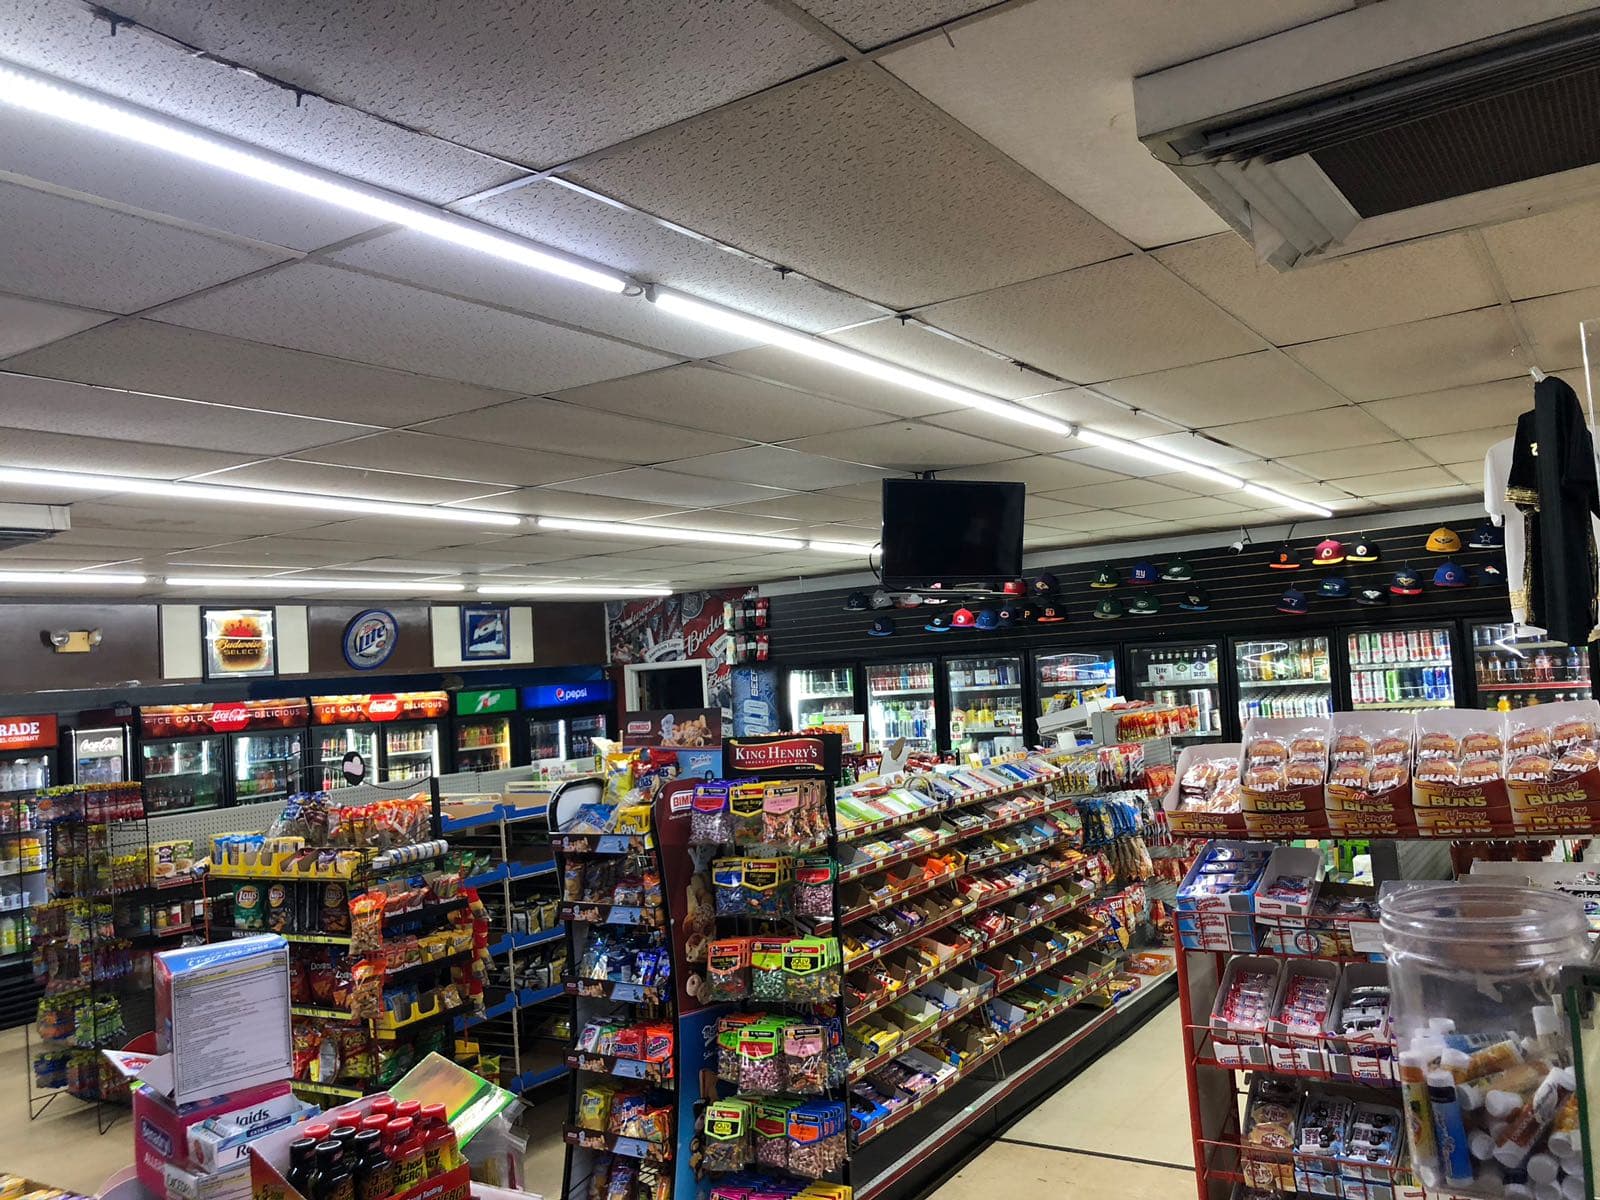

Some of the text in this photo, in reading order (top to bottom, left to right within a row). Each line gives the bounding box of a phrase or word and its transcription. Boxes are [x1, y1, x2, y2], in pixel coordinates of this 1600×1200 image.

[565, 688, 588, 701] pepsi
[340, 705, 362, 713] COLD
[403, 701, 443, 710] DELICIOUS
[153, 716, 171, 725] ICE
[176, 715, 203, 724] COLD
[254, 708, 300, 718] DELICIOUS
[8, 734, 40, 742] COMPANY
[736, 745, 818, 760] KING HENRY'S
[1537, 780, 1579, 795] Honey
[1430, 796, 1488, 806] BUNS
[1526, 790, 1588, 806] BUNS
[1257, 801, 1306, 811] BUNS
[1342, 801, 1395, 811] BUNS
[1544, 805, 1587, 818] Honey
[1446, 810, 1487, 820] Honey
[1196, 902, 1226, 912] Cupcakes
[1353, 1070, 1386, 1078] Donuts
